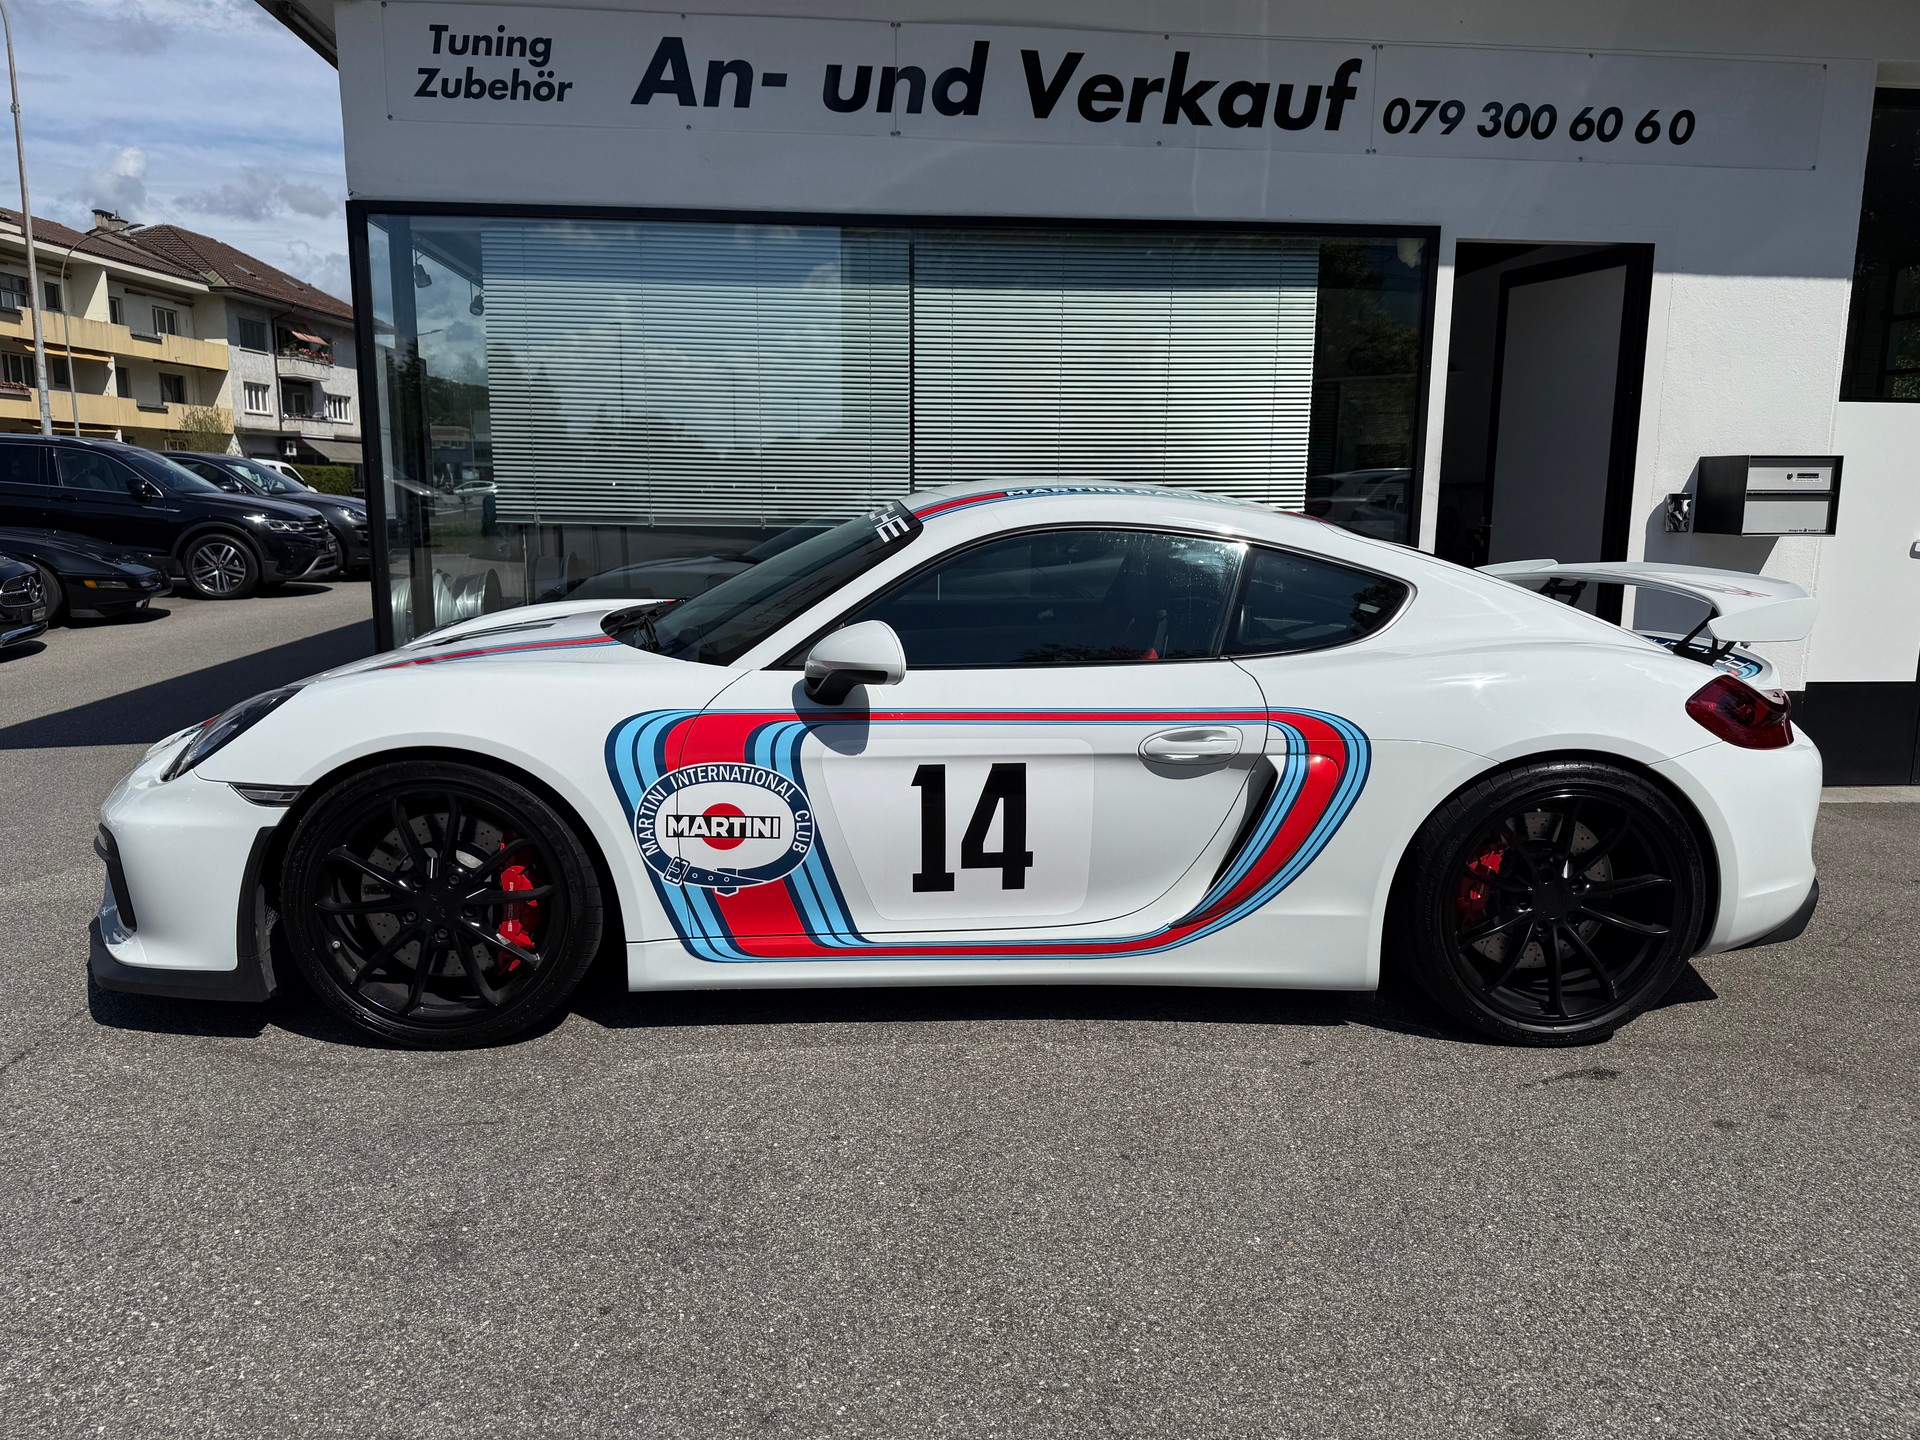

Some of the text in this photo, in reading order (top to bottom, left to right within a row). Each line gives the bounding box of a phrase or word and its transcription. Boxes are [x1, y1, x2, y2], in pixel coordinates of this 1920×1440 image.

[428, 24, 553, 68] Tuning
[413, 66, 573, 102] Zubehör
[630, 36, 1363, 132] An- und Verkauf
[1382, 97, 1466, 136] 079
[1476, 101, 1558, 141] 300
[1568, 106, 1624, 143] 60
[638, 765, 811, 857] MARTINI INTERNATIONAL CLUB
[667, 815, 780, 838] MARTINI
[910, 762, 1034, 893] 14
